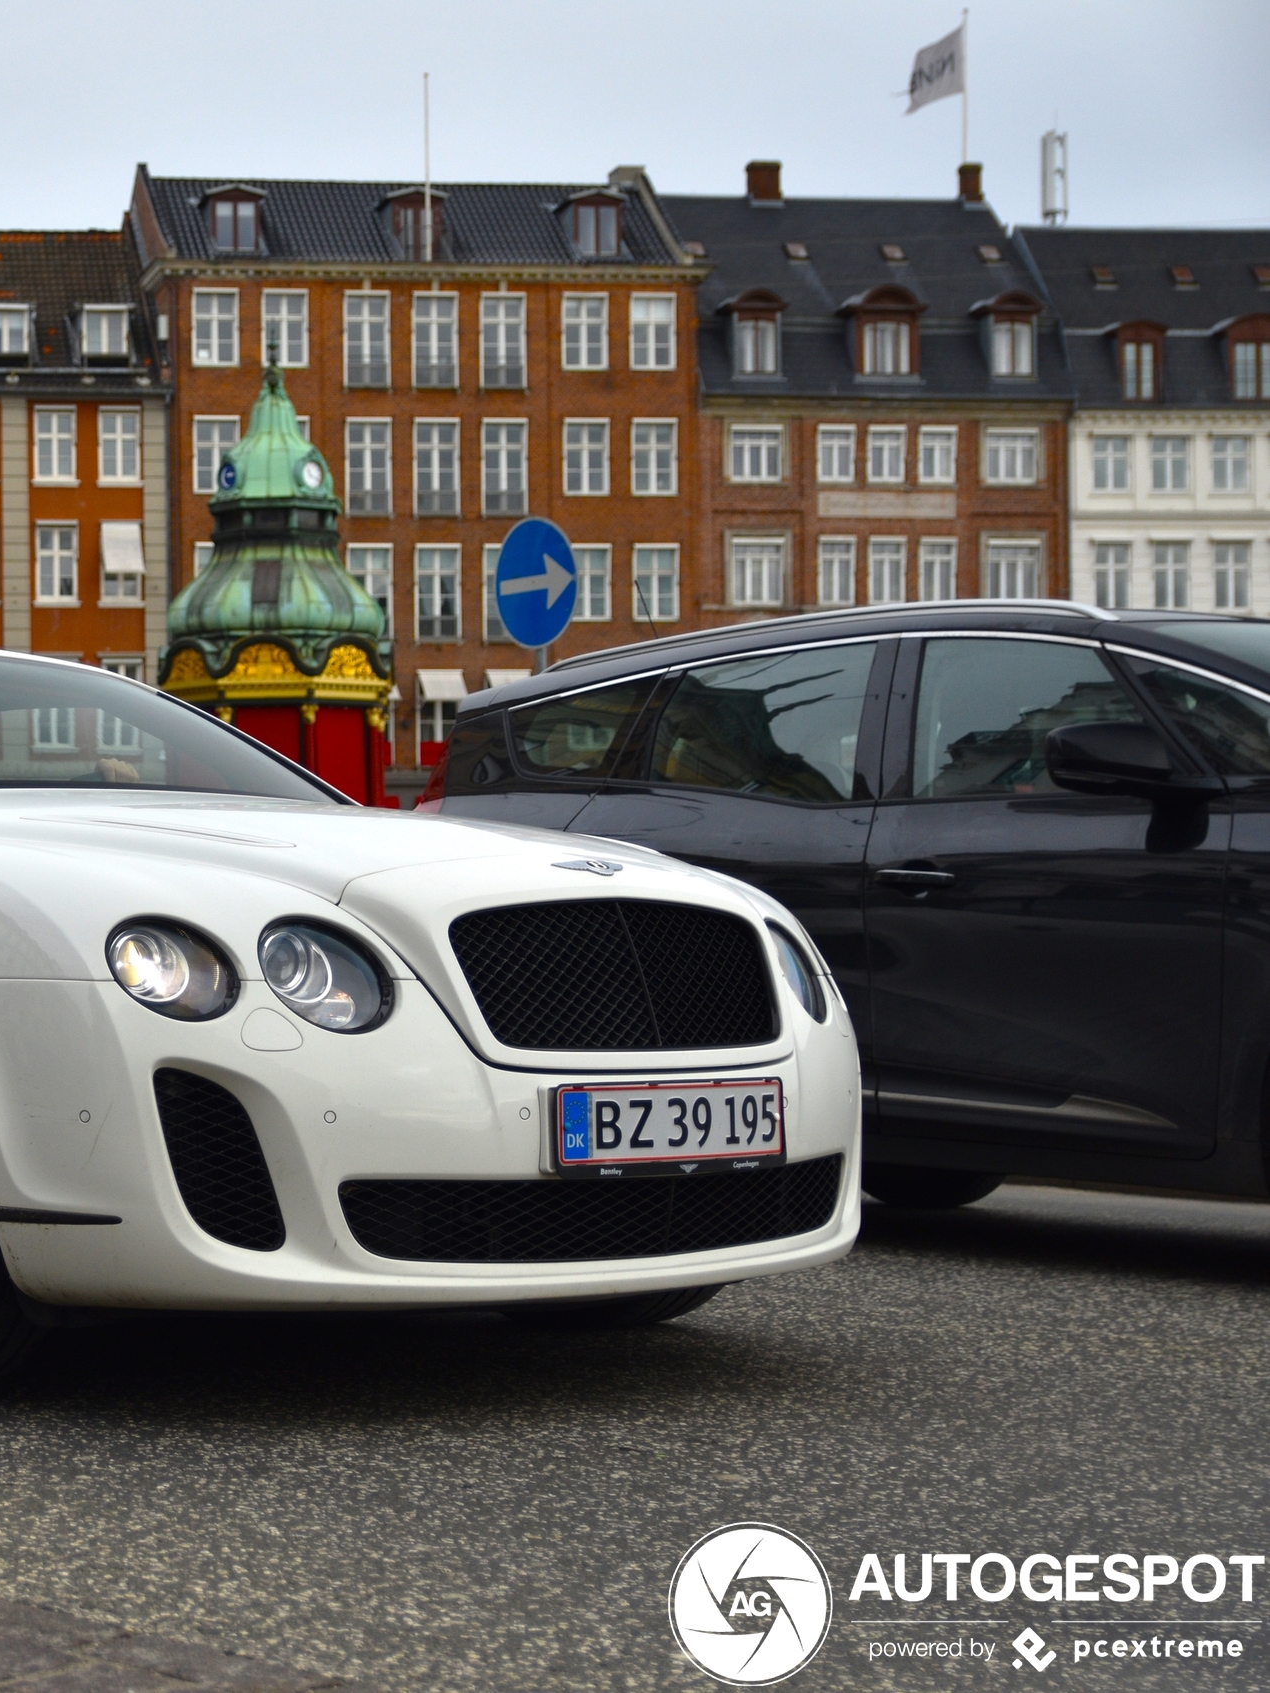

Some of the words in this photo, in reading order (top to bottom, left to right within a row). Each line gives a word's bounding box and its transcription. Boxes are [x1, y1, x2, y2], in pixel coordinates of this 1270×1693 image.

[595, 1099, 655, 1150] BZ
[667, 1096, 712, 1148] 39
[725, 1093, 777, 1147] 195
[567, 1132, 585, 1149] DK
[600, 1168, 623, 1176] Bentley
[733, 1161, 760, 1169] Copenhagen
